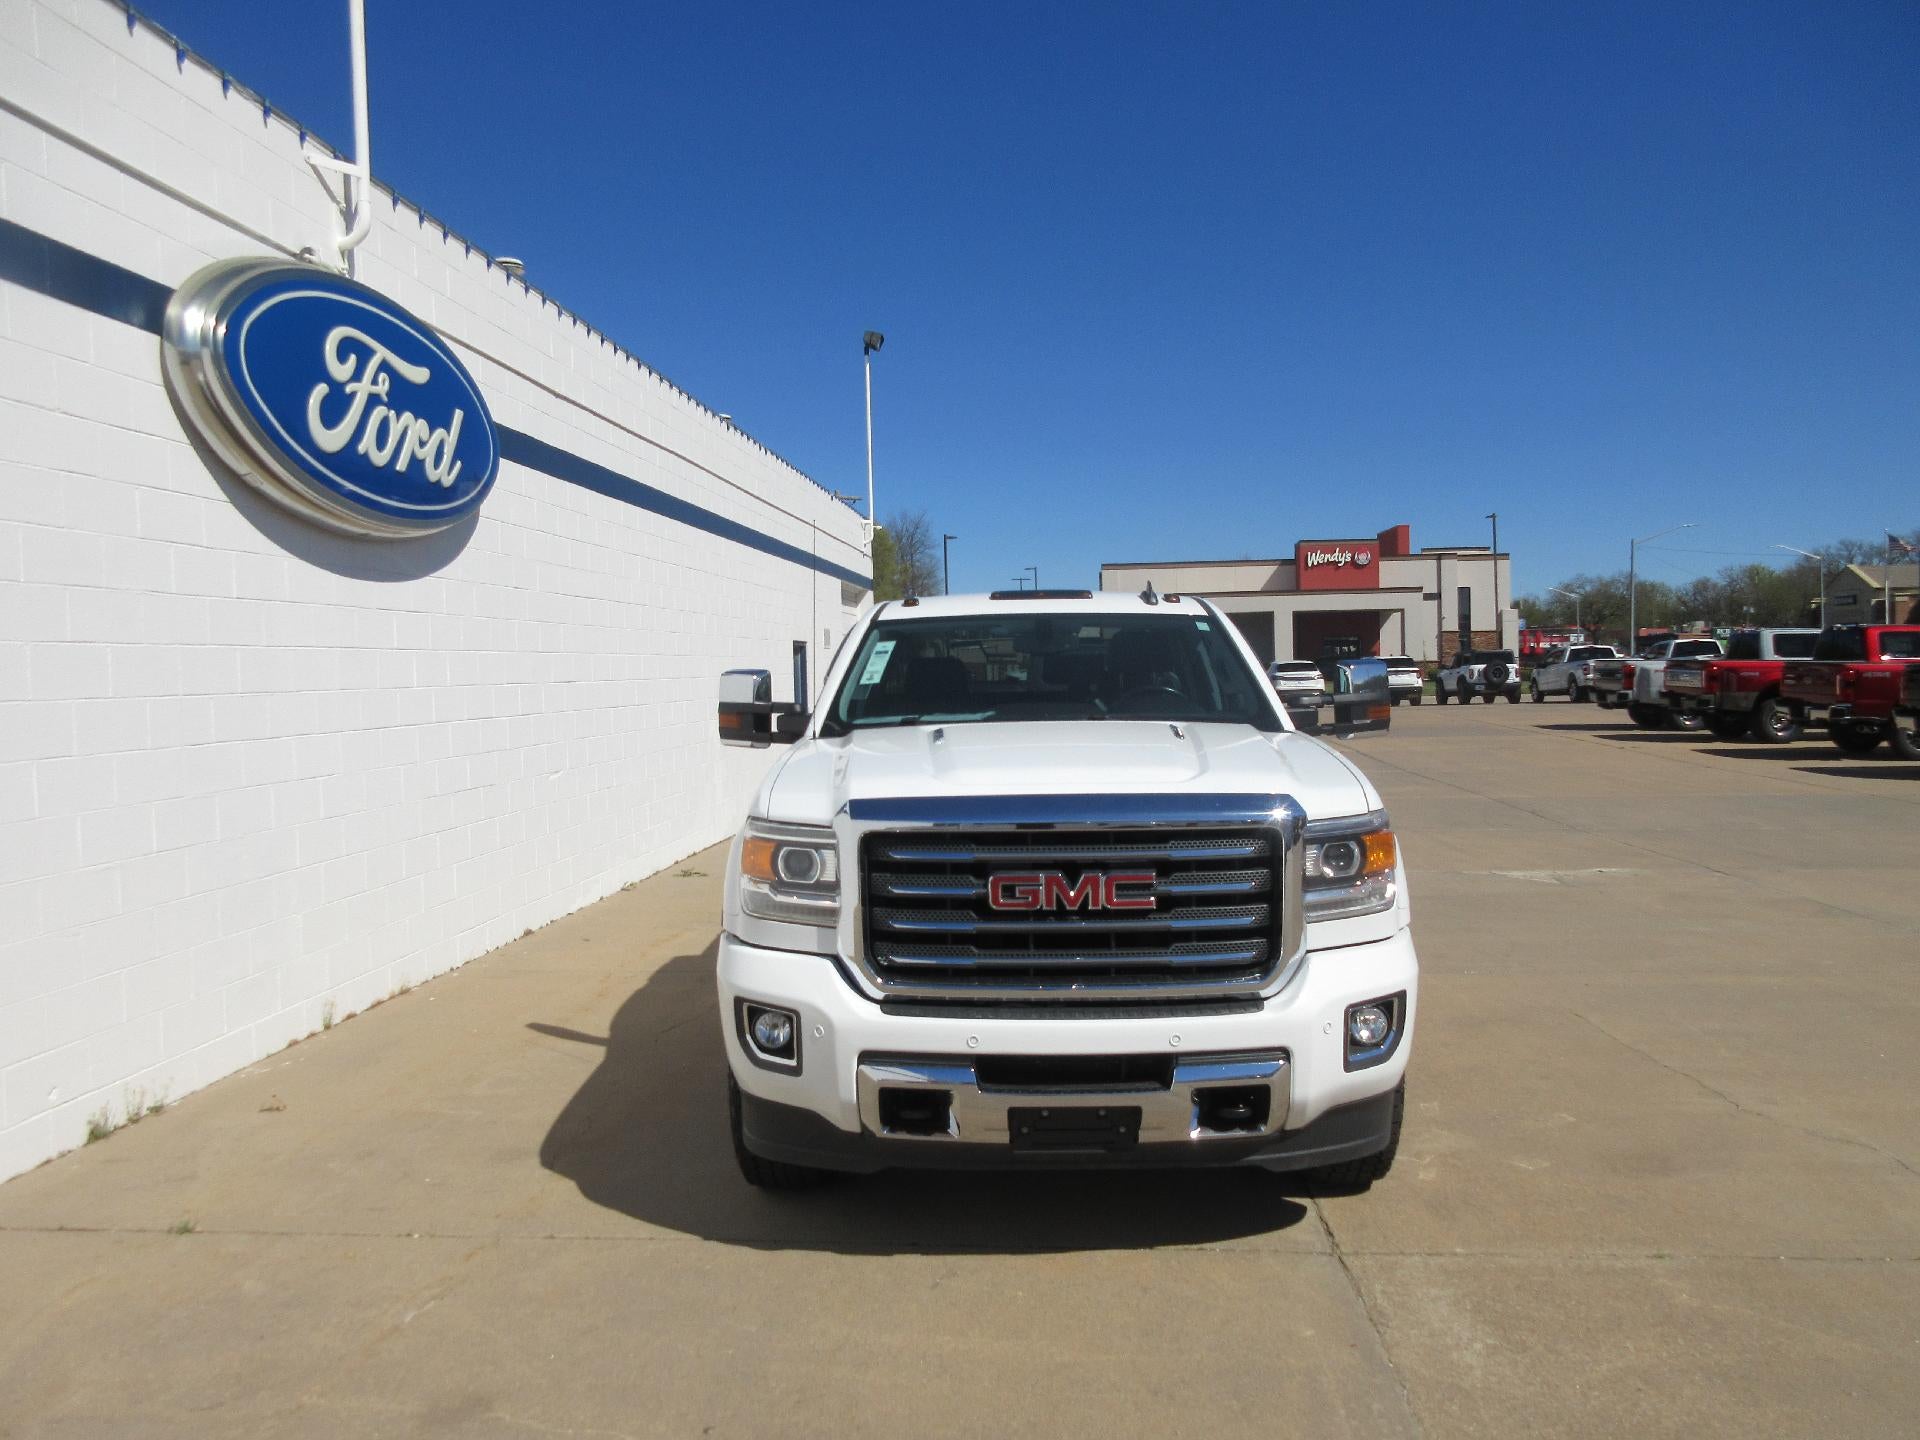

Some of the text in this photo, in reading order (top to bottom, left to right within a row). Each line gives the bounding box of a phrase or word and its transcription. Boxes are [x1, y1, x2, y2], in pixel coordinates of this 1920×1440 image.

[307, 326, 464, 488] Ford
[1307, 547, 1352, 567] Wendy's
[988, 871, 1157, 910] GMC
